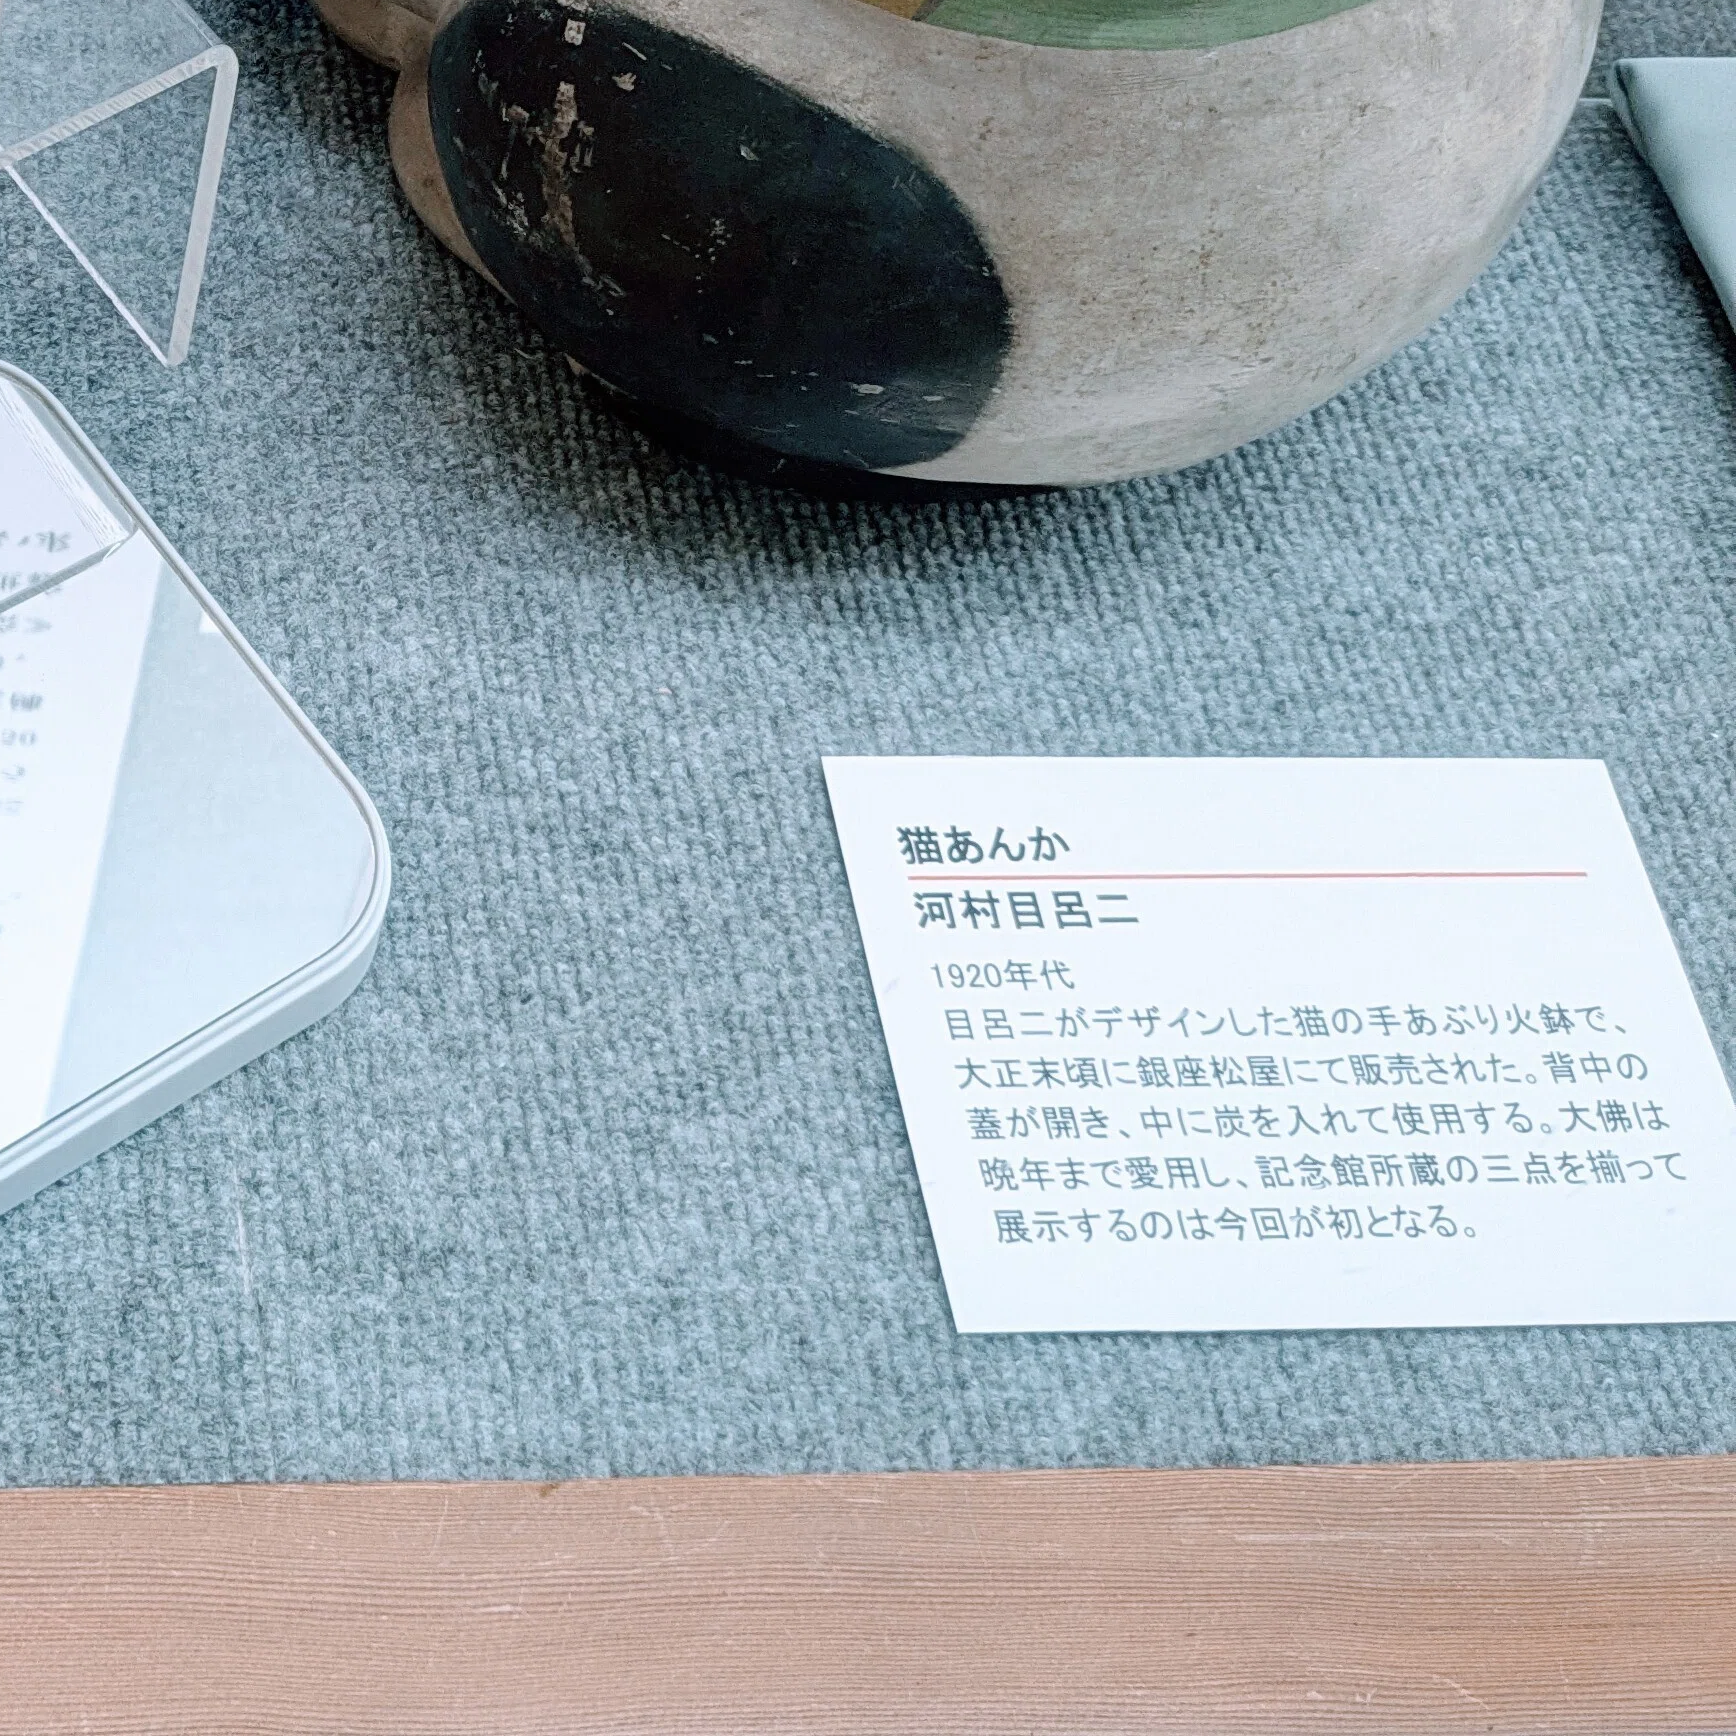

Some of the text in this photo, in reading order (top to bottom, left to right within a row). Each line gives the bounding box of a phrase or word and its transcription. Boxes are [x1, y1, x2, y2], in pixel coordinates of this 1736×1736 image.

[895, 824, 1071, 865] 猫あんか
[912, 889, 1140, 930] 河村目呂二
[930, 959, 1076, 992] 1920年代
[943, 1003, 1627, 1041] 目呂二がデザインした猫の手あぶり火鉢で、
[954, 1050, 1649, 1090] 大正末頃に銀座松屋にて販売された。背中の
[965, 1098, 1670, 1141] 蓋が開き、中に炭を入れて使用する。大佛は
[978, 1148, 1688, 1193] 晩年まで愛用し、記念館所蔵の三点を揃って
[993, 1204, 1477, 1244] 展示するのは今回が初となる。
